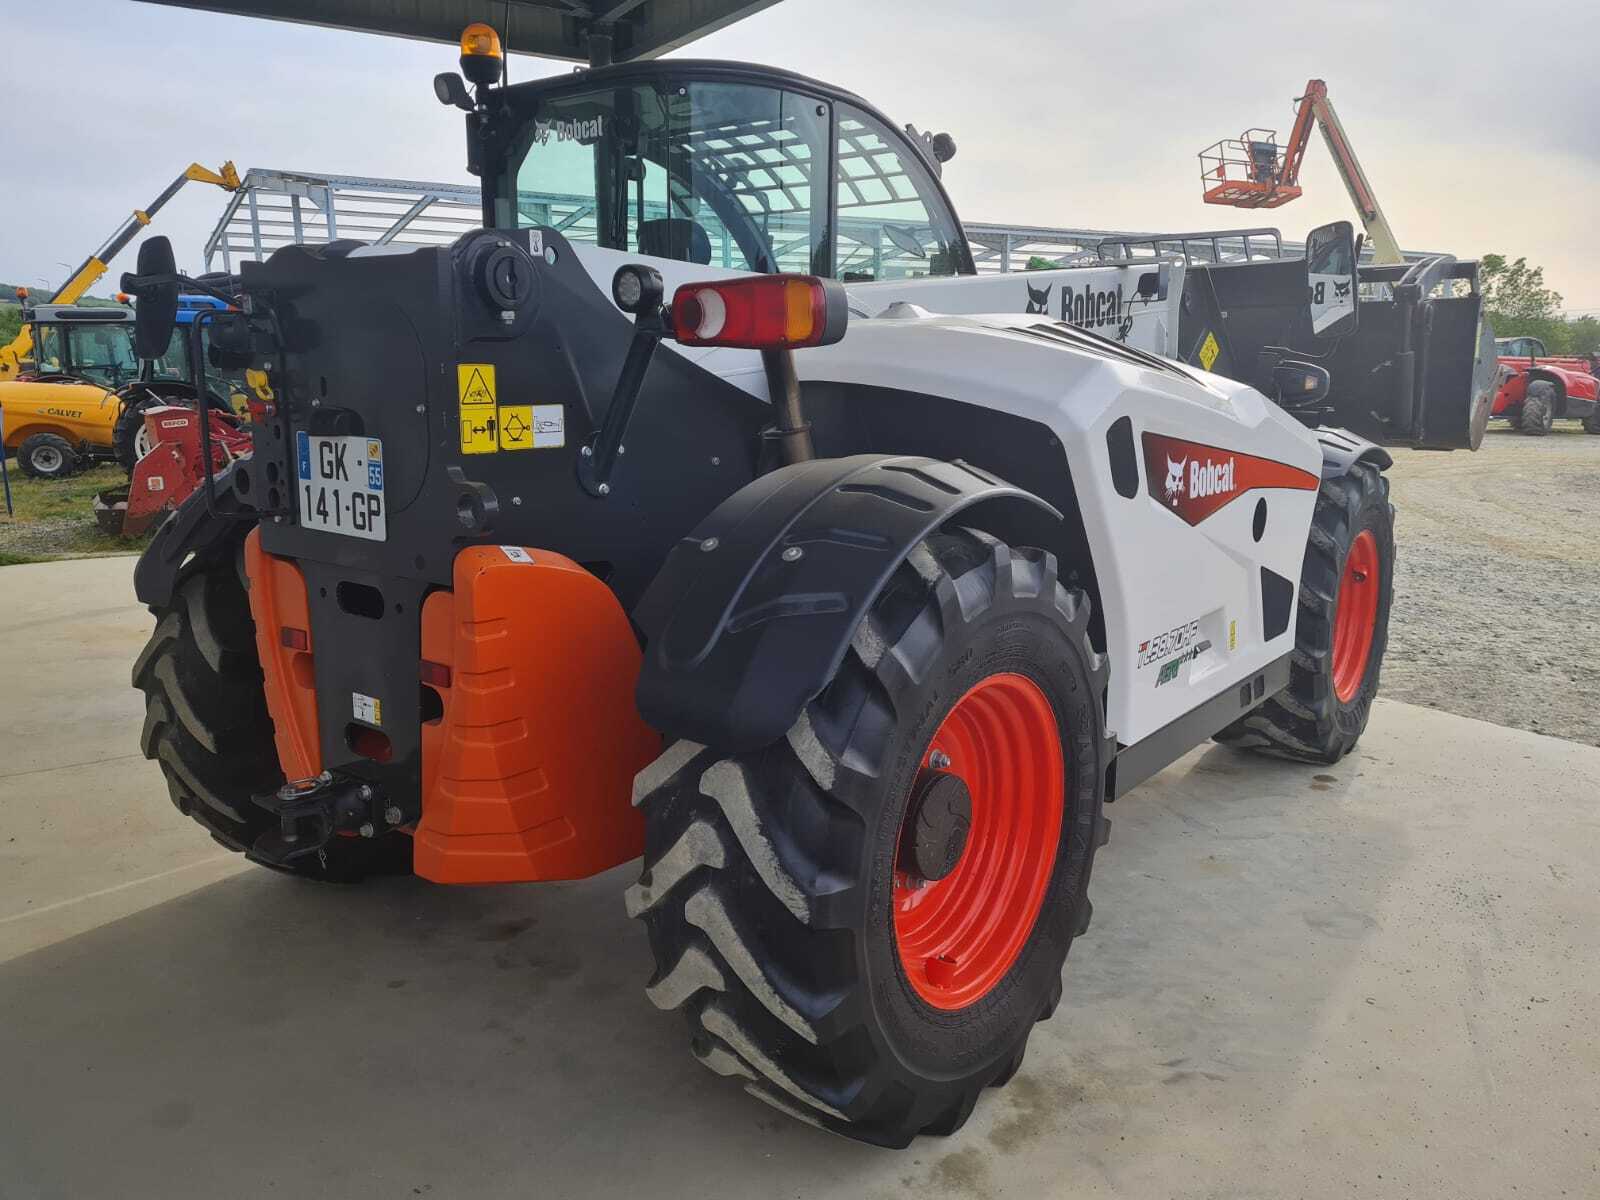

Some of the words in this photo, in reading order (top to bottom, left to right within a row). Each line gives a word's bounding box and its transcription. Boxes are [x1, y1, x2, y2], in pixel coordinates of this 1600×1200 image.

[556, 115, 603, 142] Bobcat
[1061, 283, 1122, 328] Bobcat
[47, 407, 83, 419] CALVET
[319, 441, 349, 482] GK
[368, 466, 382, 486] 55
[1189, 456, 1235, 499] Bobcat
